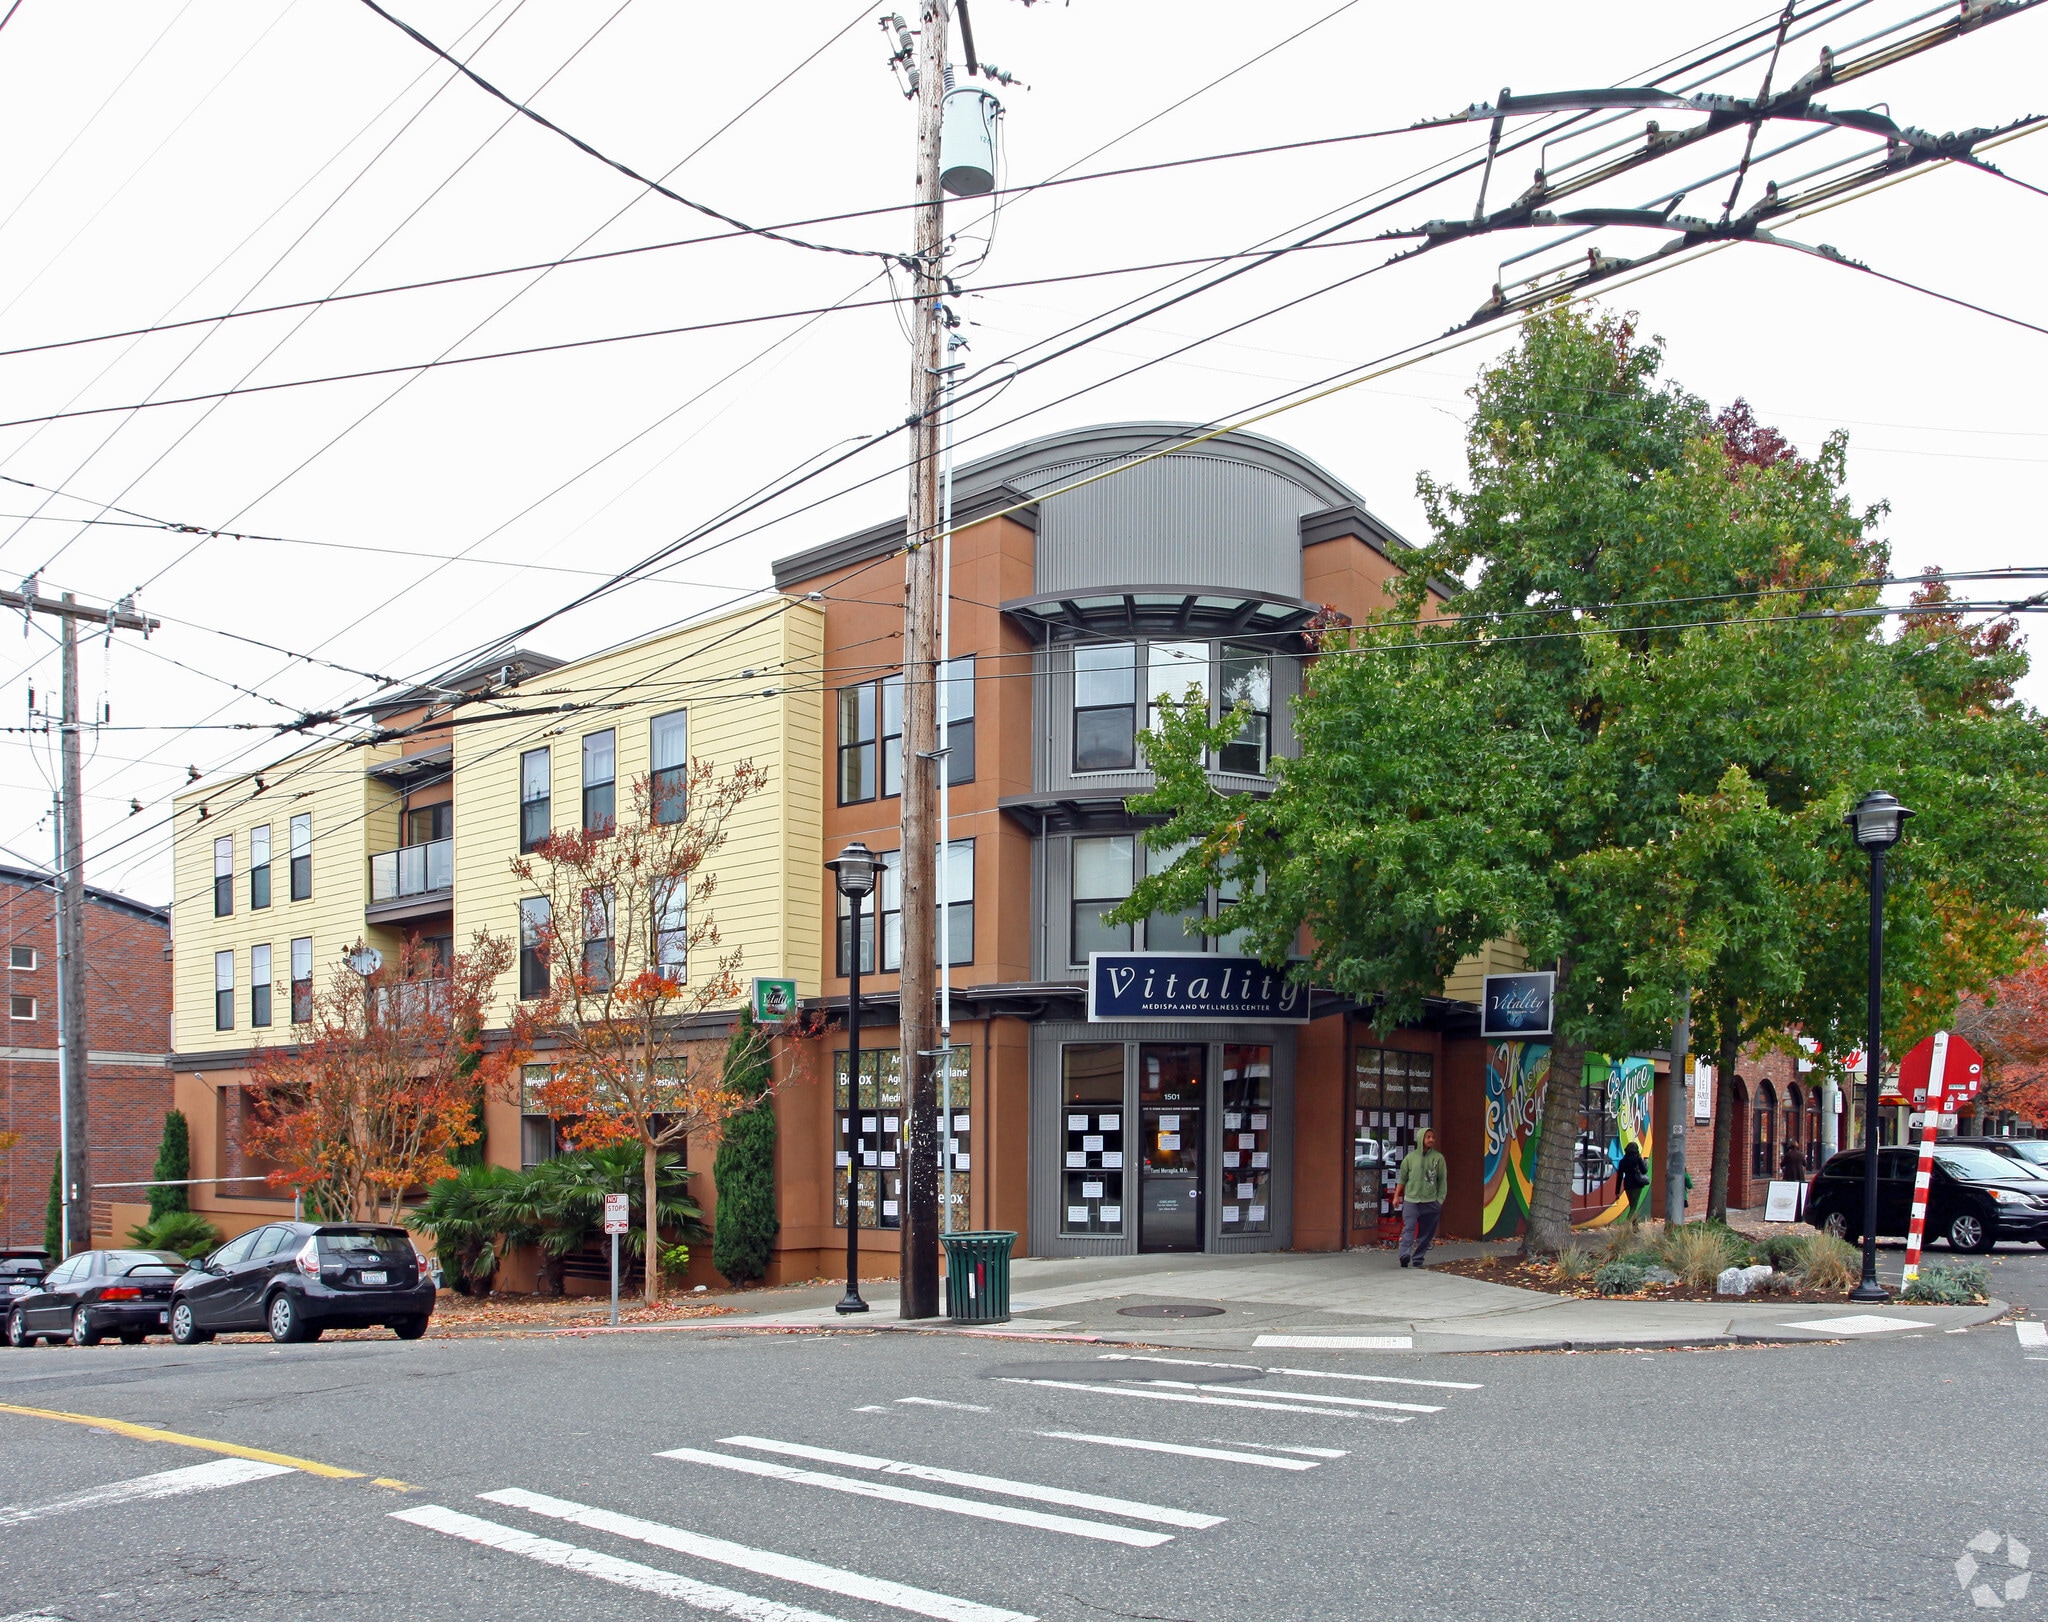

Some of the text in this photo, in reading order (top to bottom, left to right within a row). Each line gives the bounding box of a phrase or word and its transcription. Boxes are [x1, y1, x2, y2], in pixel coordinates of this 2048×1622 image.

[1106, 966, 1299, 1012] Vitality
[1491, 987, 1545, 1014] Vitality
[1199, 1003, 1240, 1011] WELLNESS
[840, 1073, 872, 1086] Box
[1360, 1081, 1377, 1090] Medicine
[881, 1093, 900, 1103] Medi
[1163, 1093, 1180, 1101] 1501
[1620, 1066, 1651, 1131] Juice
[1629, 1089, 1653, 1138] Bar
[1361, 1184, 1371, 1193] HCG
[607, 1204, 627, 1212] STOPS
[839, 1197, 875, 1209] Tigning
[1354, 1201, 1368, 1211] Weight
